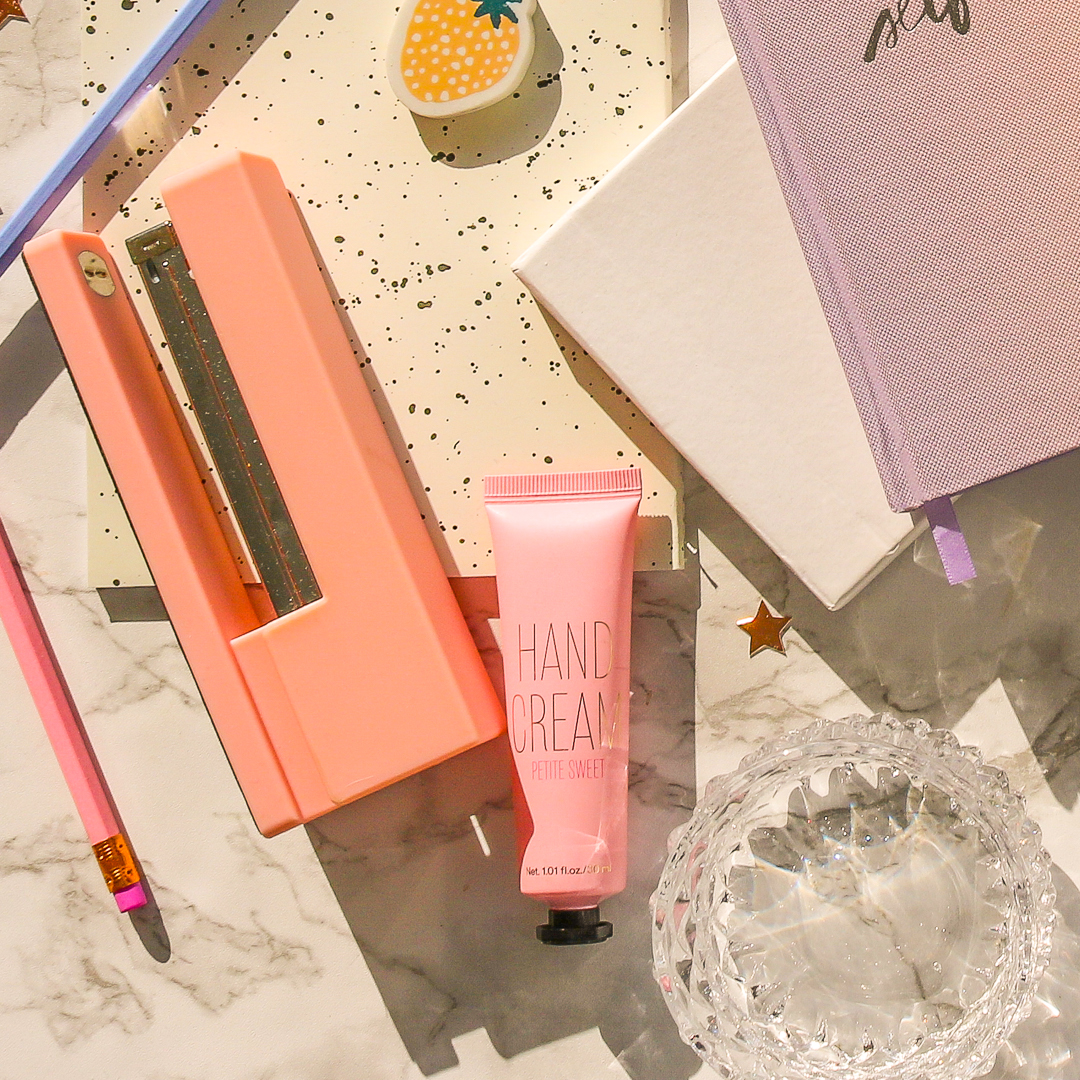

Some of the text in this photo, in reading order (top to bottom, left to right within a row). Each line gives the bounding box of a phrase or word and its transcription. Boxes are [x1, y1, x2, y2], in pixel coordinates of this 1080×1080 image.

[518, 621, 613, 682] HAND
[511, 691, 622, 754] CREAM
[531, 758, 606, 780] PETITE SWEET
[525, 866, 540, 876] Net.
[542, 866, 558, 876] 1.01
